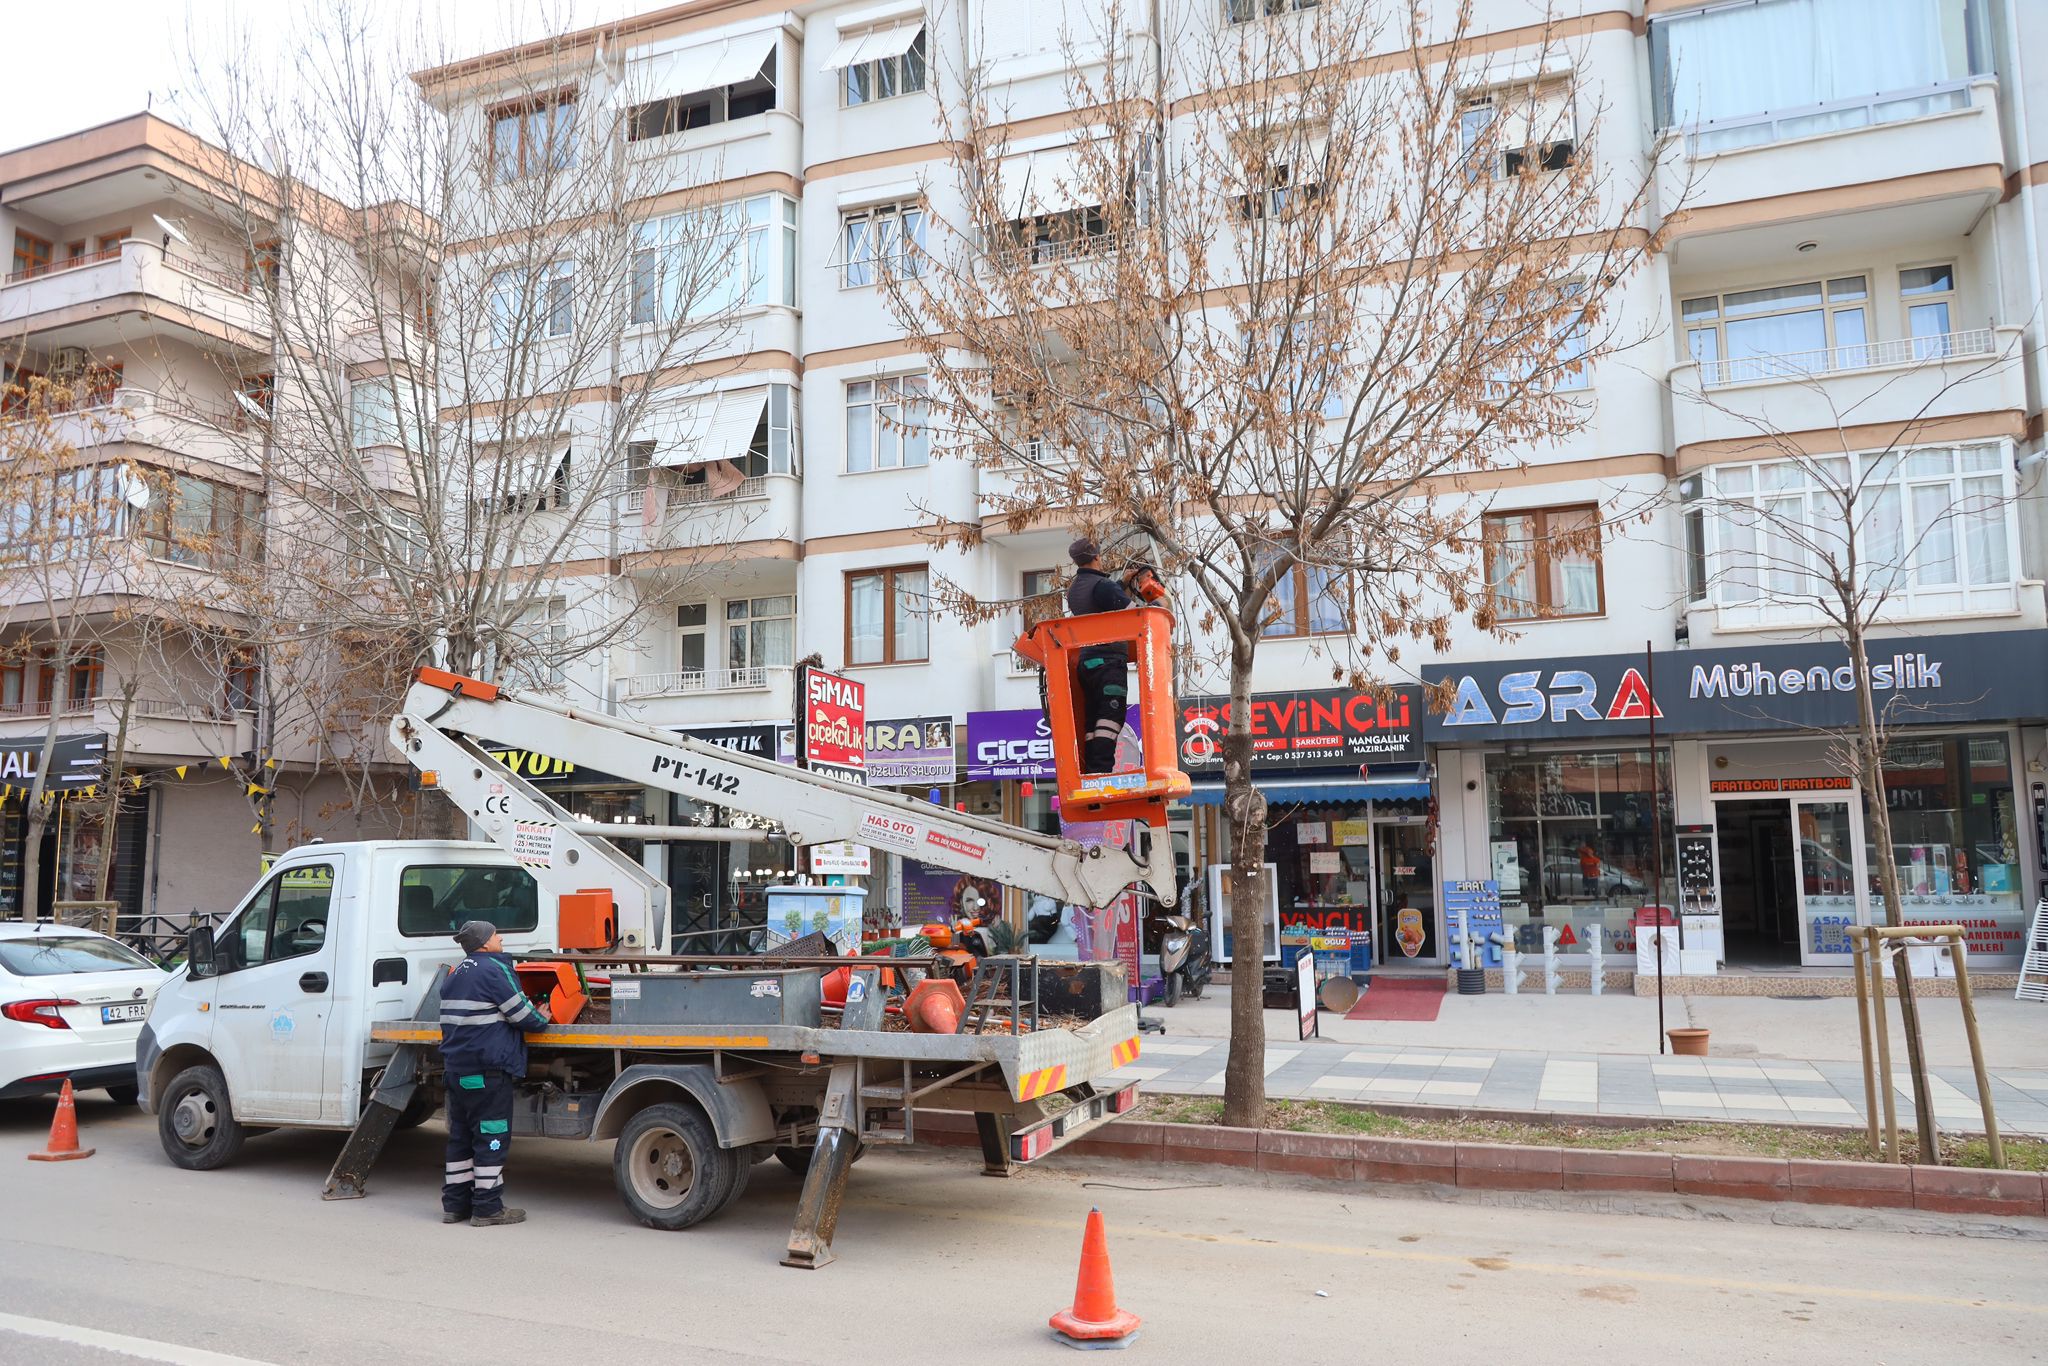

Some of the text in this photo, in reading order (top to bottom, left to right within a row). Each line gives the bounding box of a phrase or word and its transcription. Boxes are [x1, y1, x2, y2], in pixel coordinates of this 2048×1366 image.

[1689, 653, 1943, 699] Mühendslik
[1442, 667, 1665, 726] ASRA
[702, 735, 764, 751] TRiK
[1253, 740, 1274, 748] AVUK
[1295, 736, 1339, 748] ŞARKÜTERİ
[1348, 734, 1410, 746] MANGALLIK
[977, 739, 1055, 764] ÇiÇE
[1353, 744, 1405, 753] HAZIRLANIR
[1266, 752, 1283, 761] Cep:
[1291, 751, 1306, 759] 537
[1323, 750, 1333, 758] 36
[1334, 749, 1344, 757] 01
[652, 755, 740, 796] PT-142
[911, 765, 951, 776] SALONU
[992, 767, 1020, 776] Mehmet
[1020, 766, 1030, 775] Ali
[1711, 777, 1850, 792] FIRATBORU FIRATBORU
[486, 796, 509, 814] CE
[867, 815, 890, 828] HAS
[892, 822, 914, 835] OTO
[1456, 880, 1487, 891] FIRAT
[1813, 916, 1851, 925] ASRA
[1903, 918, 1954, 927] OĞALGAZ
[1963, 930, 2022, 940] LANDIRMA
[1815, 944, 1853, 953] ASRA
[1966, 943, 2005, 952] EMLERİ
[109, 1005, 146, 1019] 42 FRA
